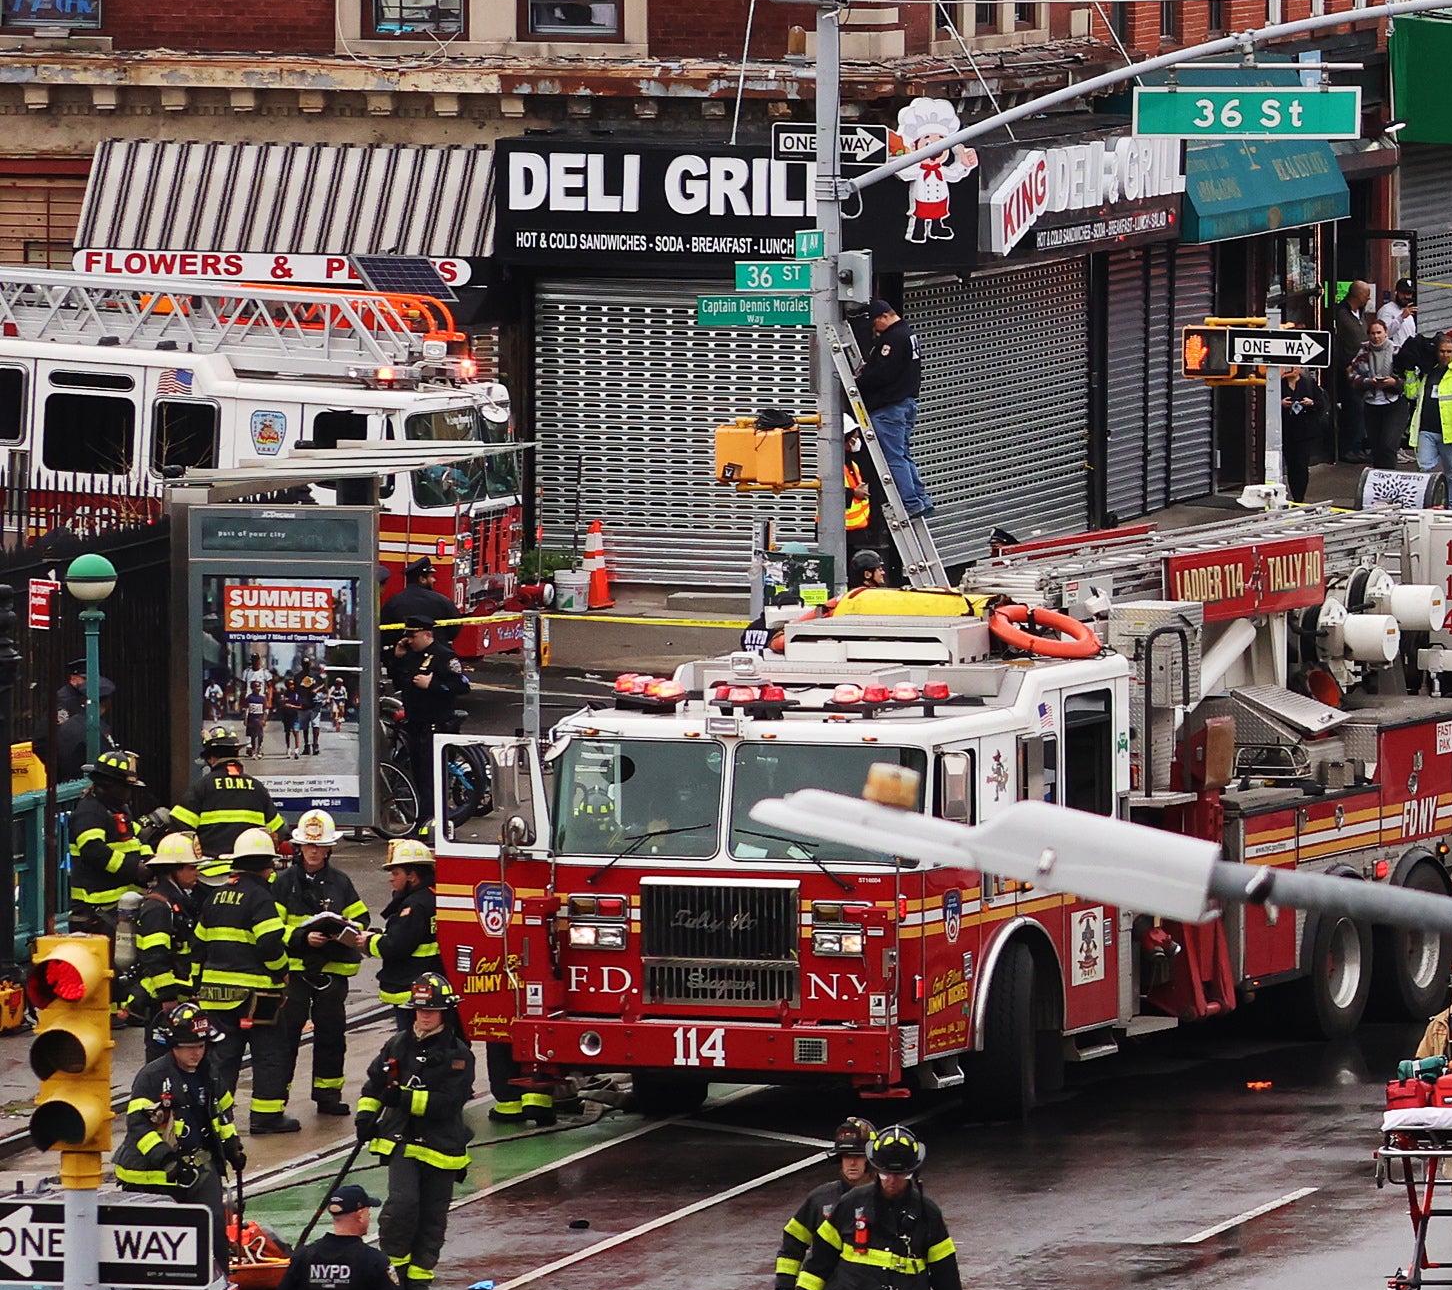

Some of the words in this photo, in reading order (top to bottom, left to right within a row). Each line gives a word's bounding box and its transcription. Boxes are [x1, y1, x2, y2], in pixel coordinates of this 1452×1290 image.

[1193, 98, 1243, 128] 36
[1259, 98, 1303, 128] St
[510, 152, 641, 212] DELI
[1003, 159, 1047, 246] KING
[747, 265, 772, 289] 36
[783, 265, 801, 281] ST
[702, 299, 737, 315] Captain
[739, 298, 770, 312] Dennis
[774, 298, 809, 312] Morales
[747, 314, 764, 325] Way
[1242, 340, 1272, 354] ONE
[1285, 342, 1314, 357] WAY
[1176, 562, 1224, 601] LADDER
[1224, 559, 1244, 598] 114
[1267, 551, 1302, 593] TALLY
[1304, 549, 1321, 586] HO
[229, 589, 329, 608] SUMMER
[229, 610, 329, 631] STREETS
[1437, 724, 1452, 737] FAST
[1438, 739, 1452, 751] PAK
[1402, 795, 1437, 838] FDNY
[674, 1027, 728, 1066] 114
[0, 1226, 67, 1258] ONE
[115, 1229, 191, 1261] WAY
[310, 1263, 351, 1278] NYPD
